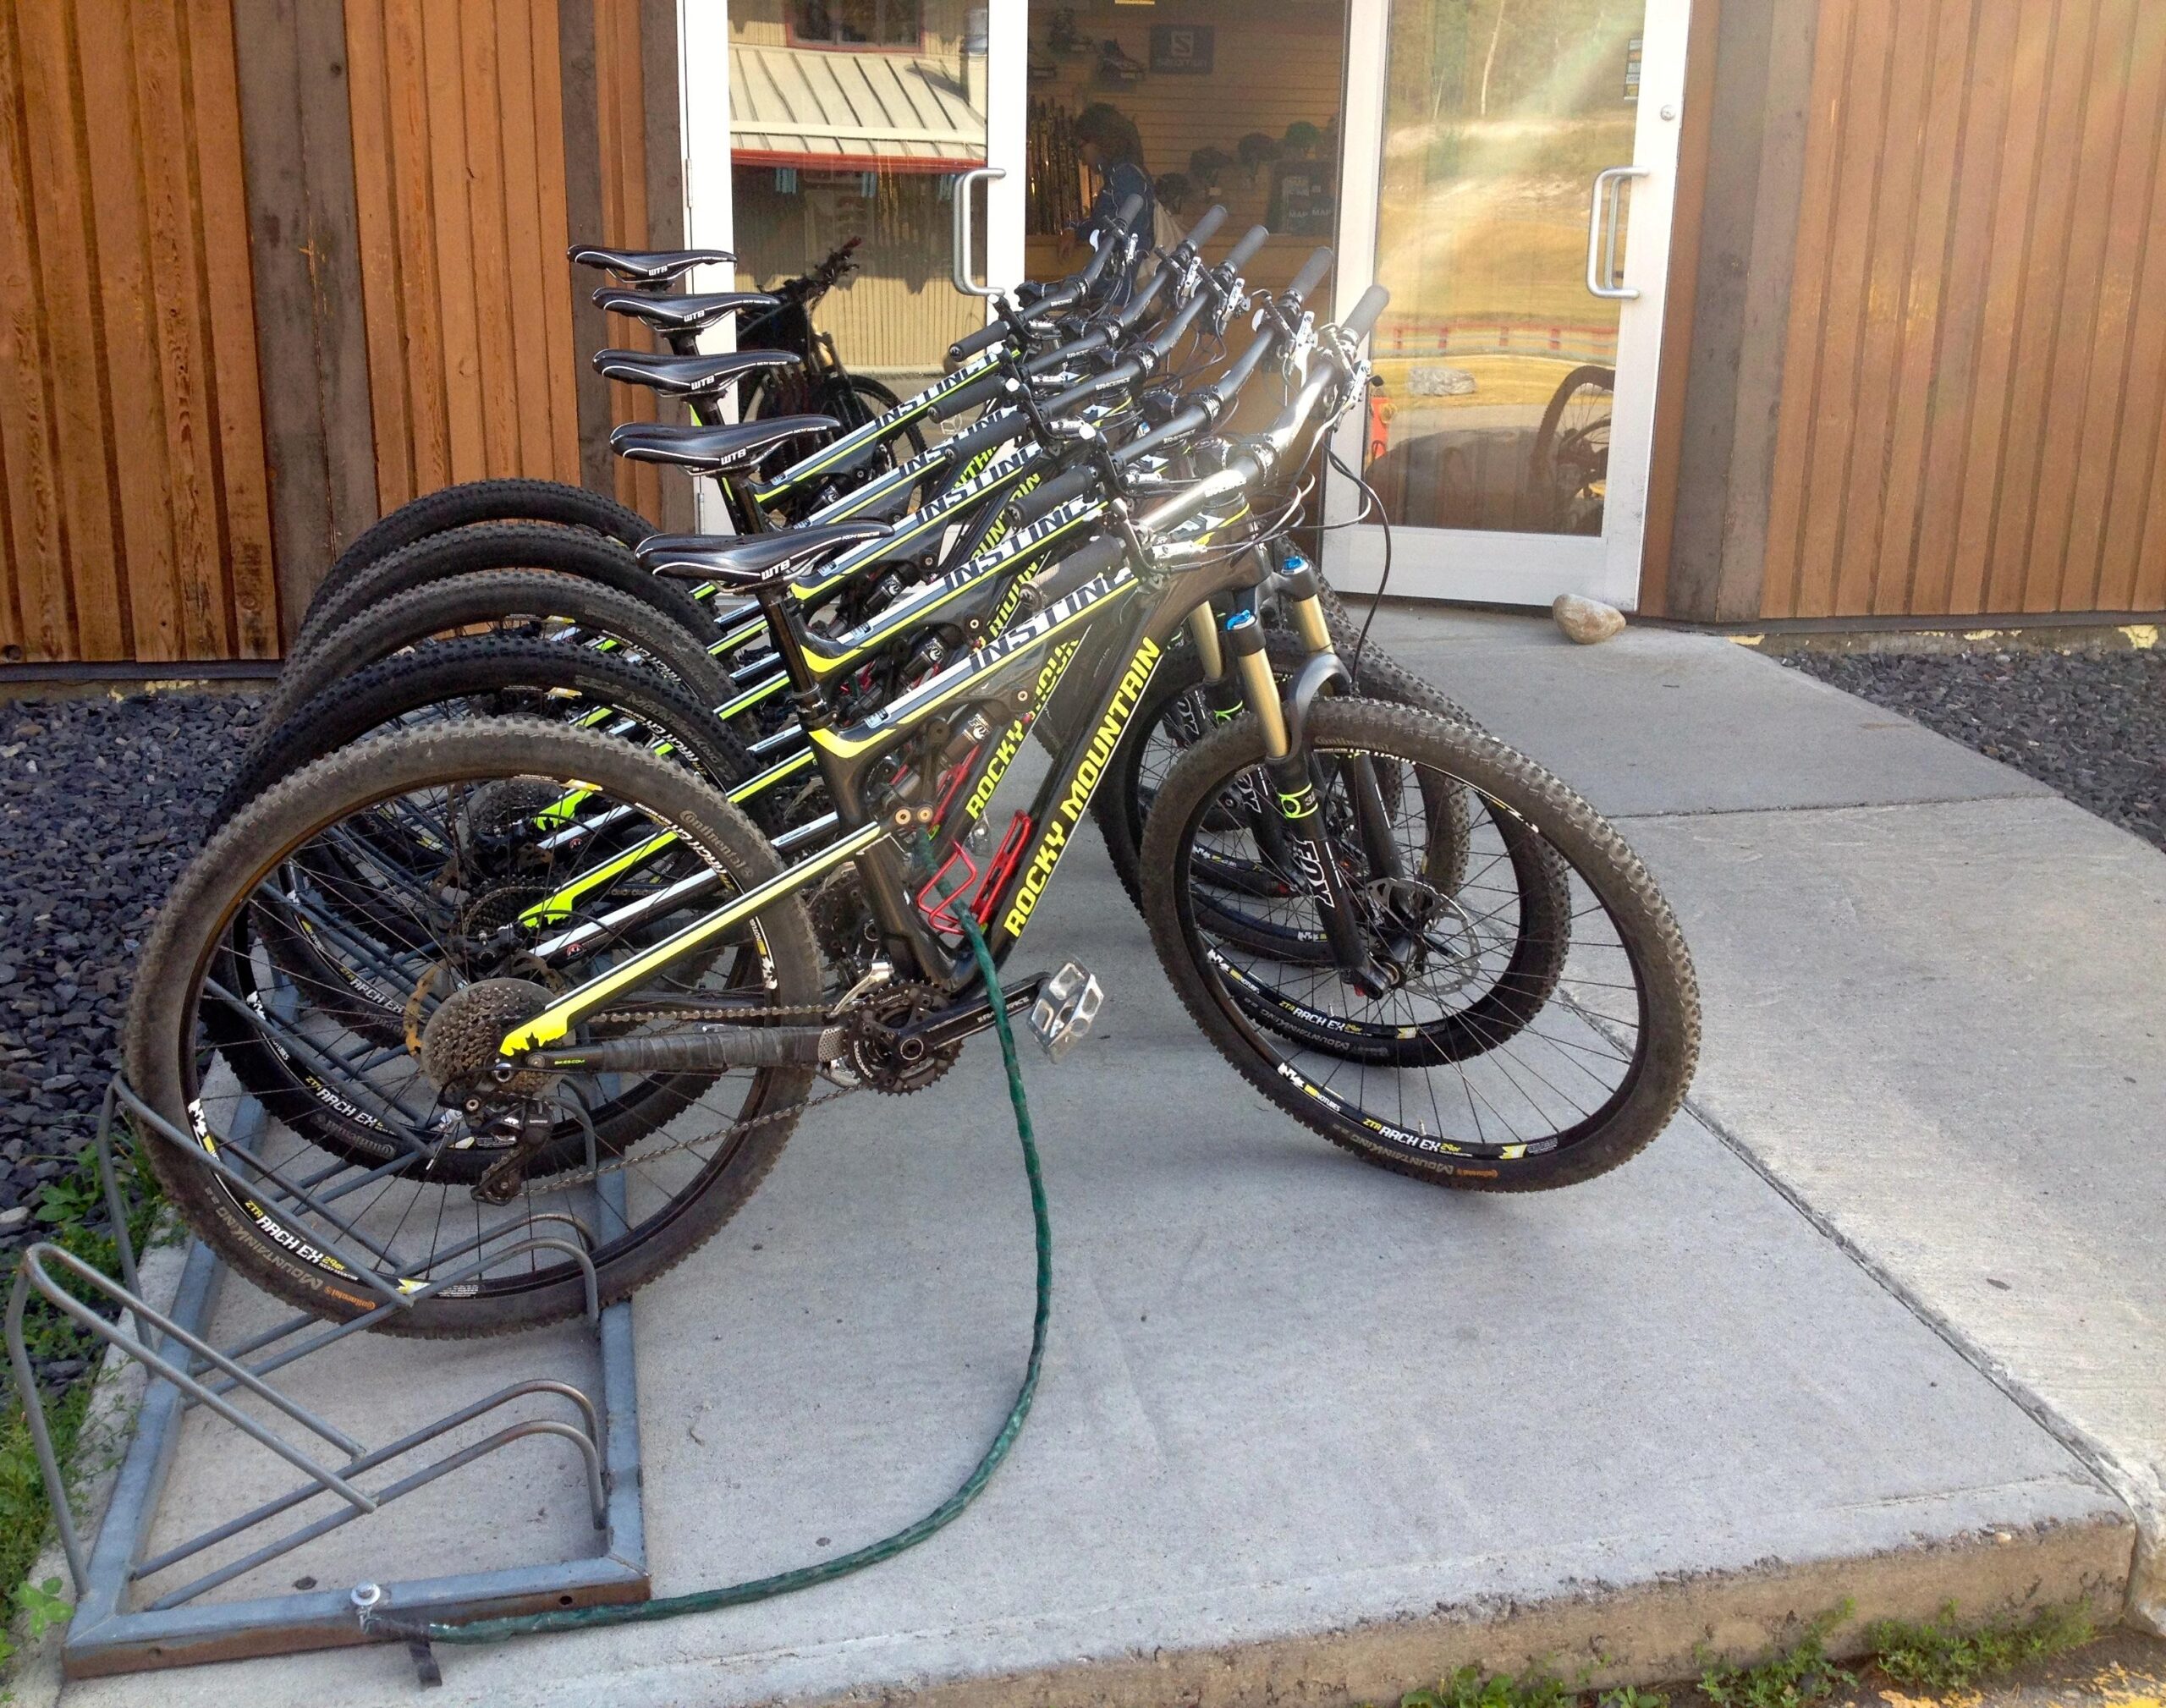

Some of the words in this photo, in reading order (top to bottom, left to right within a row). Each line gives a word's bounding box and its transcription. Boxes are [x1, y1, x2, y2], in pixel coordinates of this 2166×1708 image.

[648, 265, 668, 276] WTB
[683, 309, 706, 321] WTB
[690, 374, 715, 390] WTB
[720, 448, 746, 465] WTB
[761, 559, 791, 580] WTB
[1060, 637, 1161, 822] MOUNTAIN
[965, 719, 1025, 820] ROCKY
[679, 810, 747, 869] Continental
[687, 841, 728, 875] ARCH
[1003, 821, 1068, 938] ROCKY
[349, 978, 386, 1003] ARCH
[1292, 1008, 1328, 1026] ARCH
[1327, 1020, 1346, 1032] EX
[316, 1088, 357, 1117] ARCH
[355, 1112, 378, 1128] EX
[1315, 1092, 1342, 1112] NOTUBES
[1362, 1118, 1382, 1130] ZTR
[1379, 1126, 1420, 1147] ARCH
[1420, 1140, 1441, 1152] EX
[245, 1200, 264, 1218] ZTR
[255, 1215, 300, 1250] ARCH
[296, 1244, 324, 1265] EX
